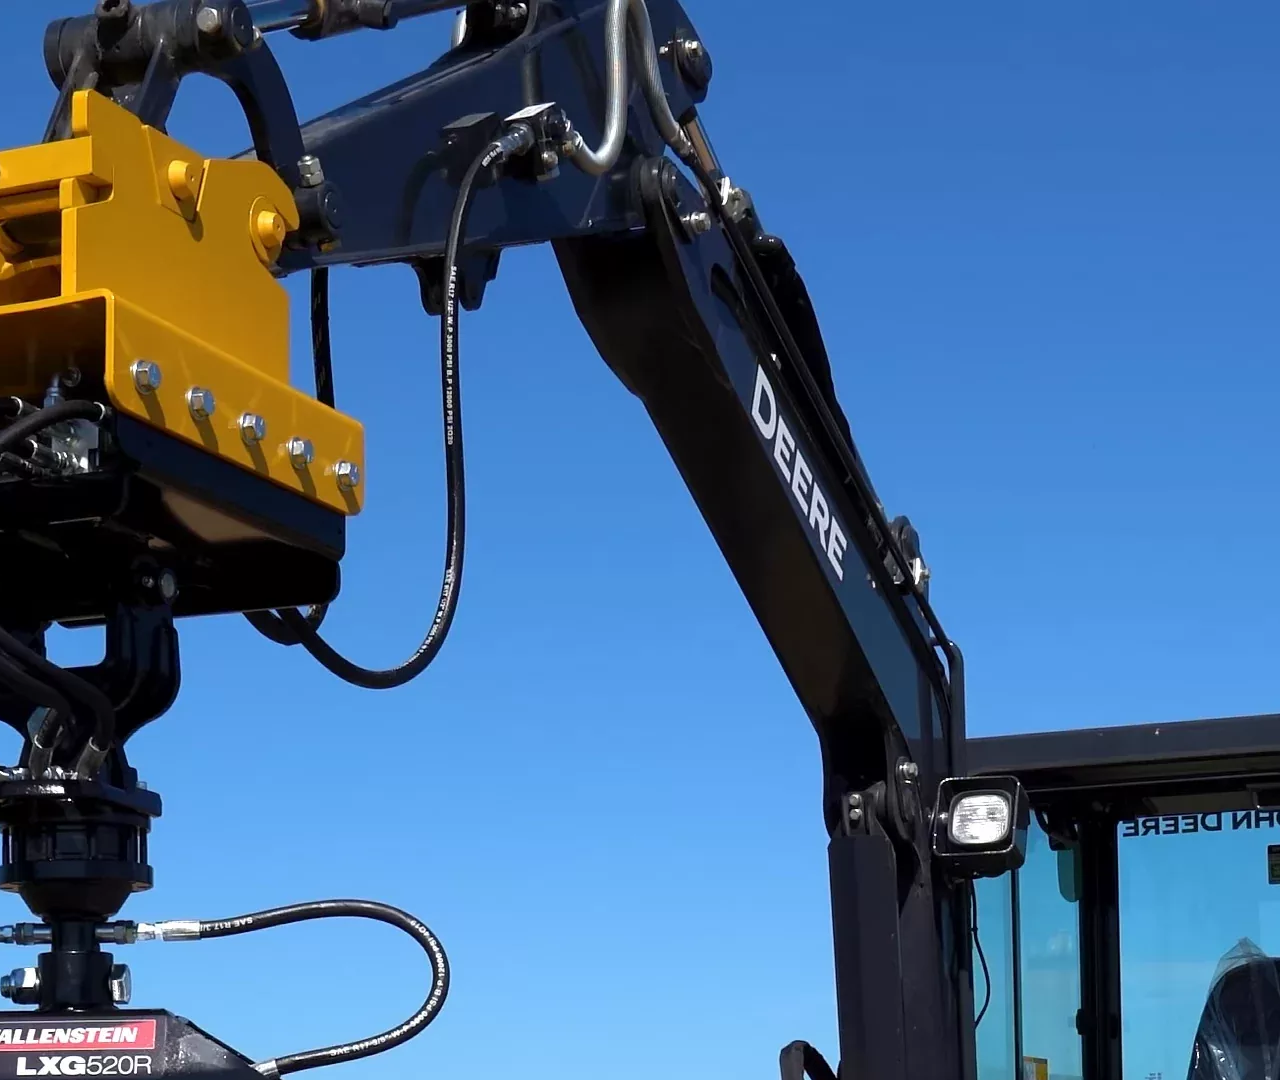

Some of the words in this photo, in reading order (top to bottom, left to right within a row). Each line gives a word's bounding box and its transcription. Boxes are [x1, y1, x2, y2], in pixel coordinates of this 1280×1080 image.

[449, 265, 457, 281] SAE
[751, 363, 848, 582] DEERE
[214, 921, 232, 931] R17
[233, 916, 254, 928] SAE
[427, 937, 440, 952] PSI
[435, 952, 445, 977] 12000
[426, 997, 439, 1011] PSI
[16, 1056, 152, 1076] LXG520R
